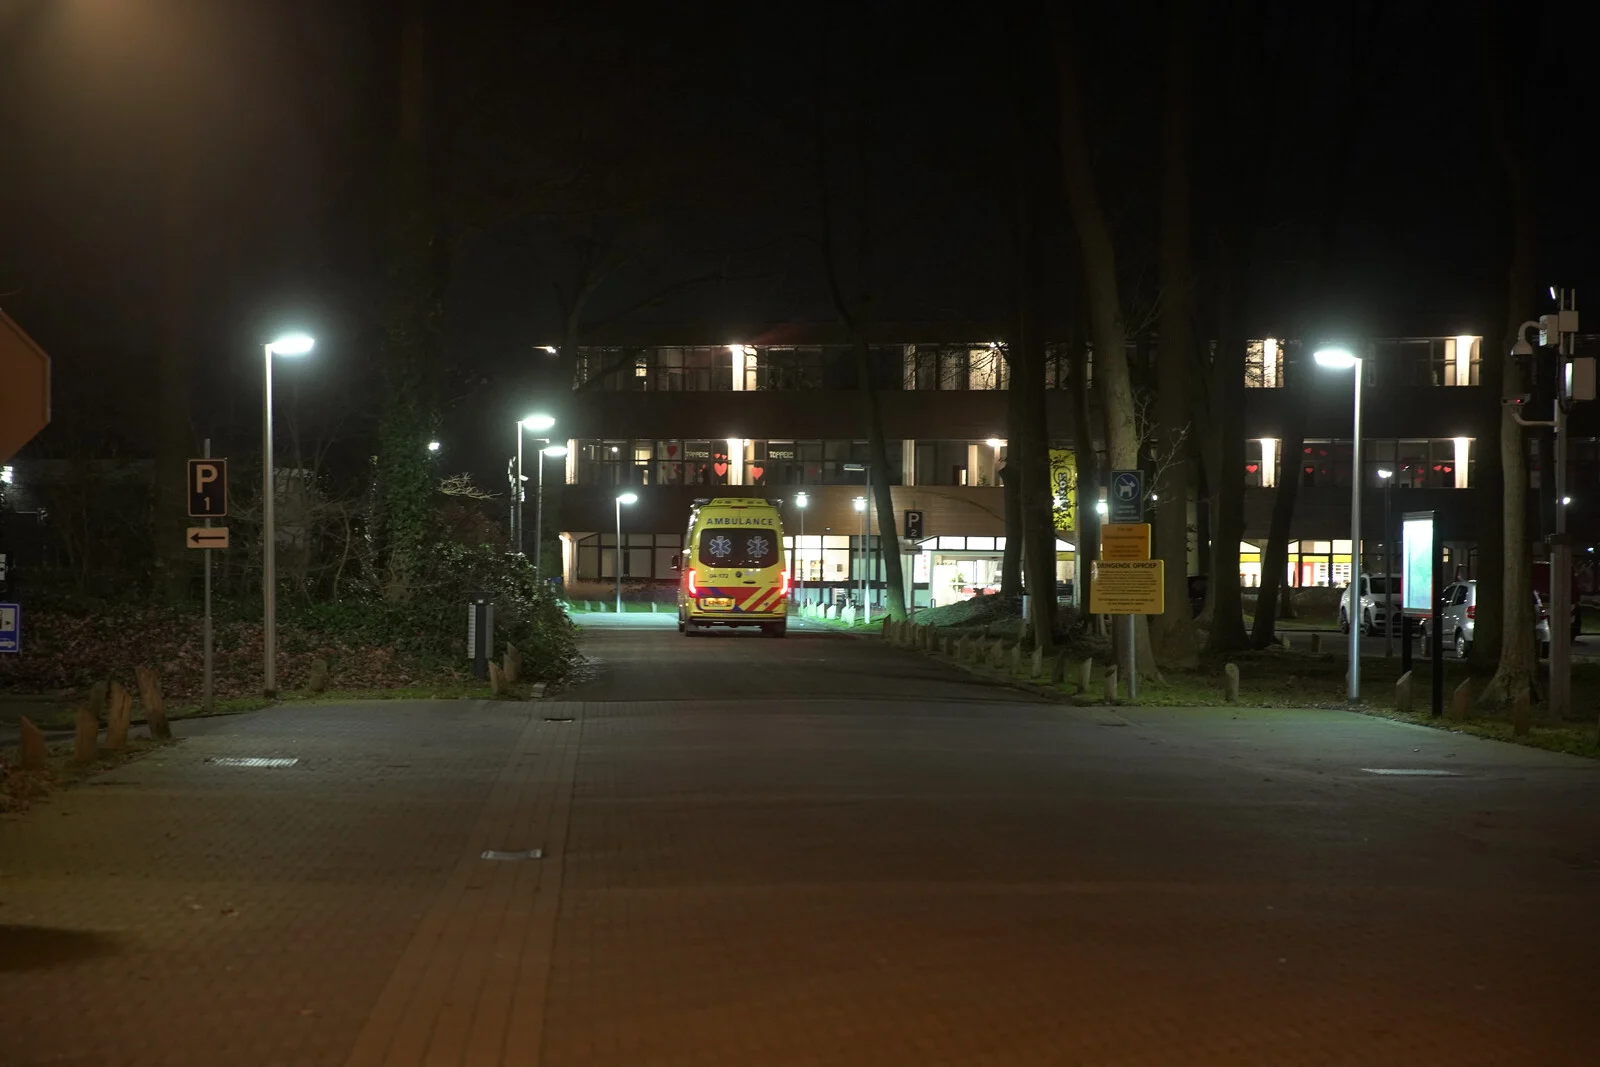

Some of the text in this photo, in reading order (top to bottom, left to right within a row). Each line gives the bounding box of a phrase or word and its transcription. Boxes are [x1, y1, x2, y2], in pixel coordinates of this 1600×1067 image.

[196, 464, 218, 493] P
[204, 496, 210, 511] 1
[706, 518, 774, 526] AMBULANCE
[908, 513, 920, 527] P
[910, 529, 917, 537] 2
